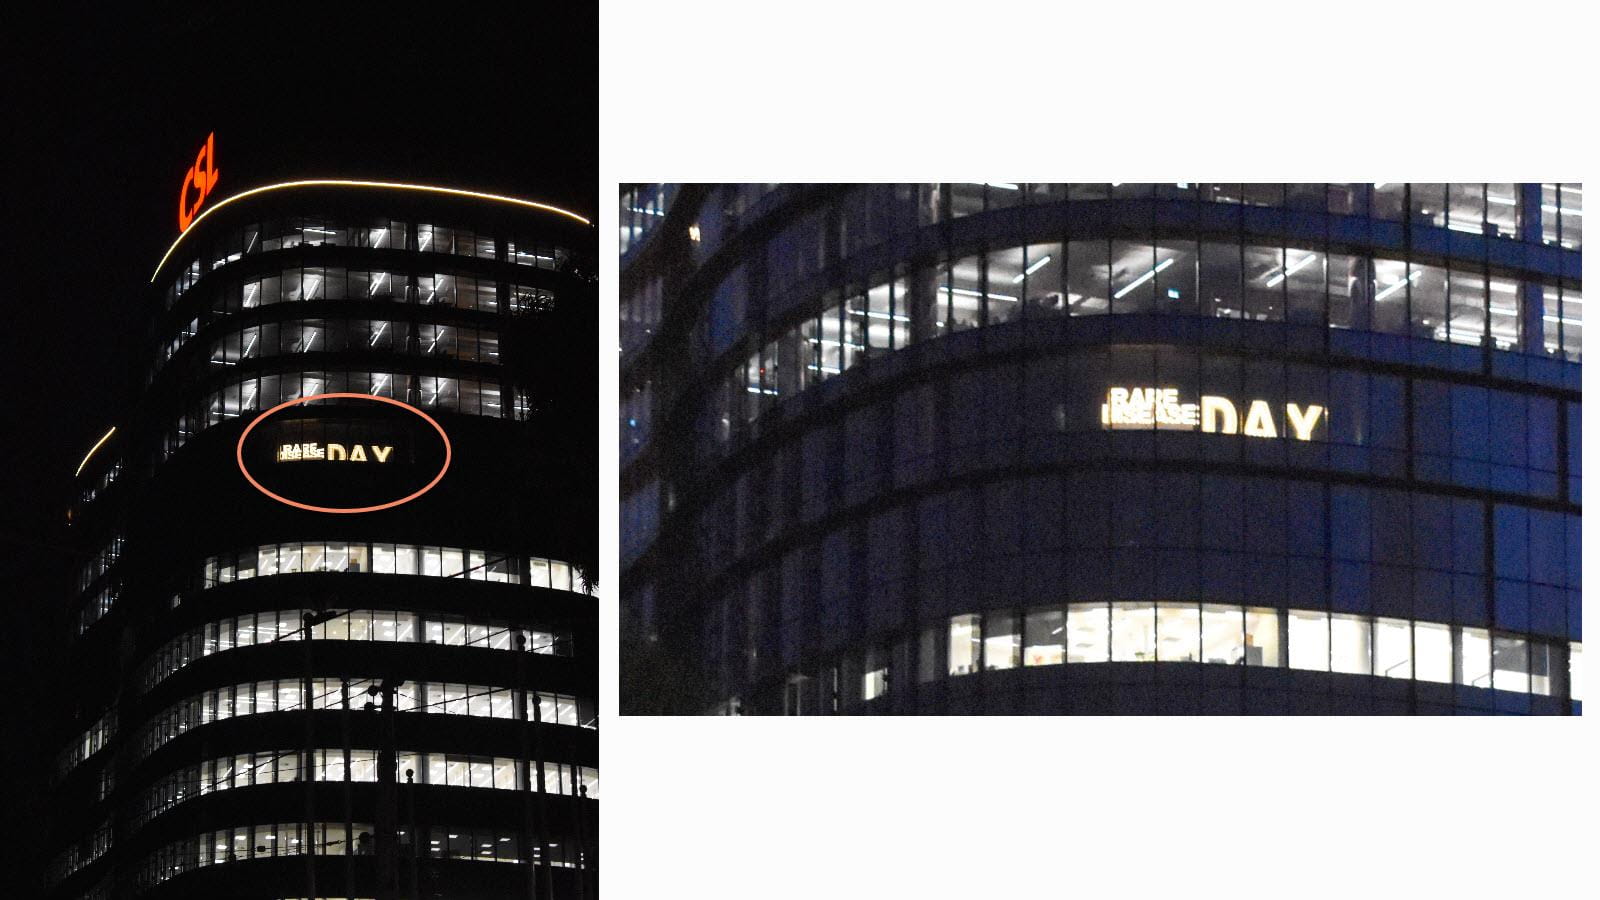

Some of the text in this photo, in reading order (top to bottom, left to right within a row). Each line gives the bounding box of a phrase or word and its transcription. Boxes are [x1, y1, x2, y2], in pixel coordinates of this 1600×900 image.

[179, 131, 219, 233] CSL
[1110, 387, 1178, 405] RARE
[1201, 395, 1323, 441] DAY
[282, 442, 318, 453] RARE
[327, 443, 393, 463] DAY
